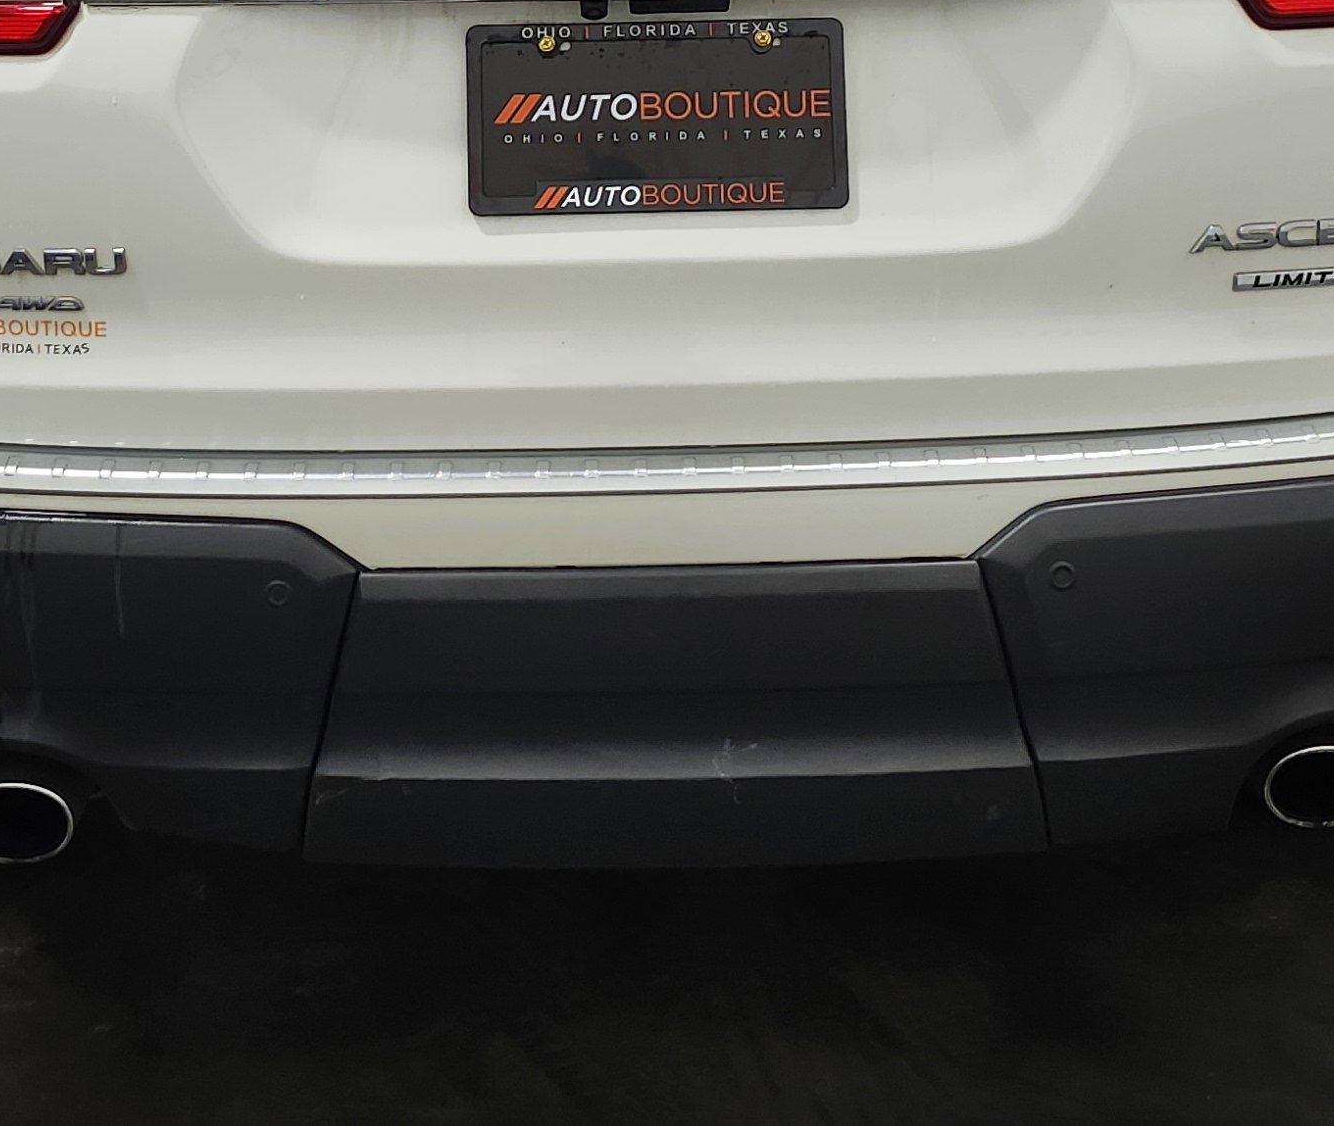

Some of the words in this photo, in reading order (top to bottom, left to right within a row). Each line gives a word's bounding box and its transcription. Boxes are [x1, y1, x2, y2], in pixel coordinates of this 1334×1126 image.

[521, 25, 572, 40] OHIO
[602, 23, 697, 38] FLORIDA
[727, 21, 788, 35] TEXAS
[504, 133, 565, 144] OHIO
[596, 130, 707, 142] FLORIDA
[743, 128, 823, 139] TEXAS
[44, 342, 90, 355] TEXAS
